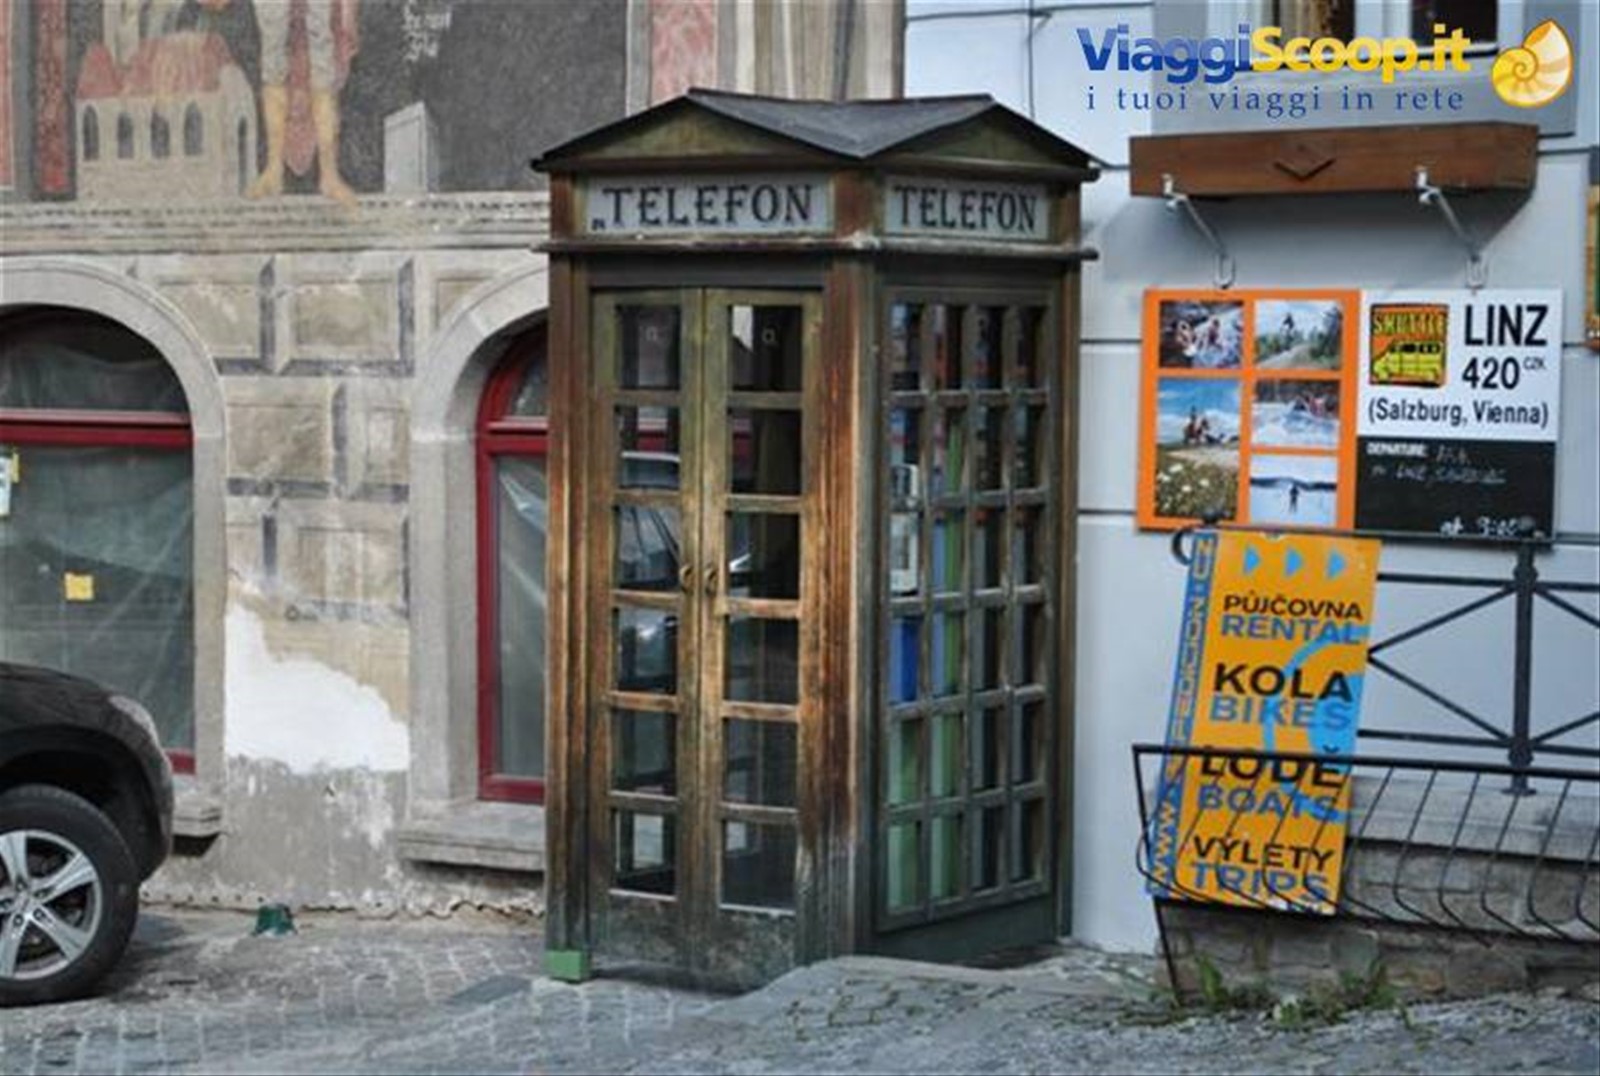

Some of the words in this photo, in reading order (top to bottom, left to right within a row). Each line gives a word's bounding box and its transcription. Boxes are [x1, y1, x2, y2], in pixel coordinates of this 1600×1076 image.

[602, 184, 814, 228] TELEFON
[896, 185, 1038, 232] TELEFON
[1464, 304, 1549, 347] LINZ
[1462, 356, 1521, 390] 420
[1368, 398, 1468, 427] (Salzburg,
[1473, 400, 1549, 429] Vienna)
[1222, 590, 1364, 621] PŮJČOVNA
[1220, 614, 1361, 646] RENTAL
[1213, 662, 1354, 703] KOLA
[1209, 696, 1352, 731] BIKES
[1197, 784, 1340, 820] BOATS
[1190, 862, 1329, 902] TRIPS
